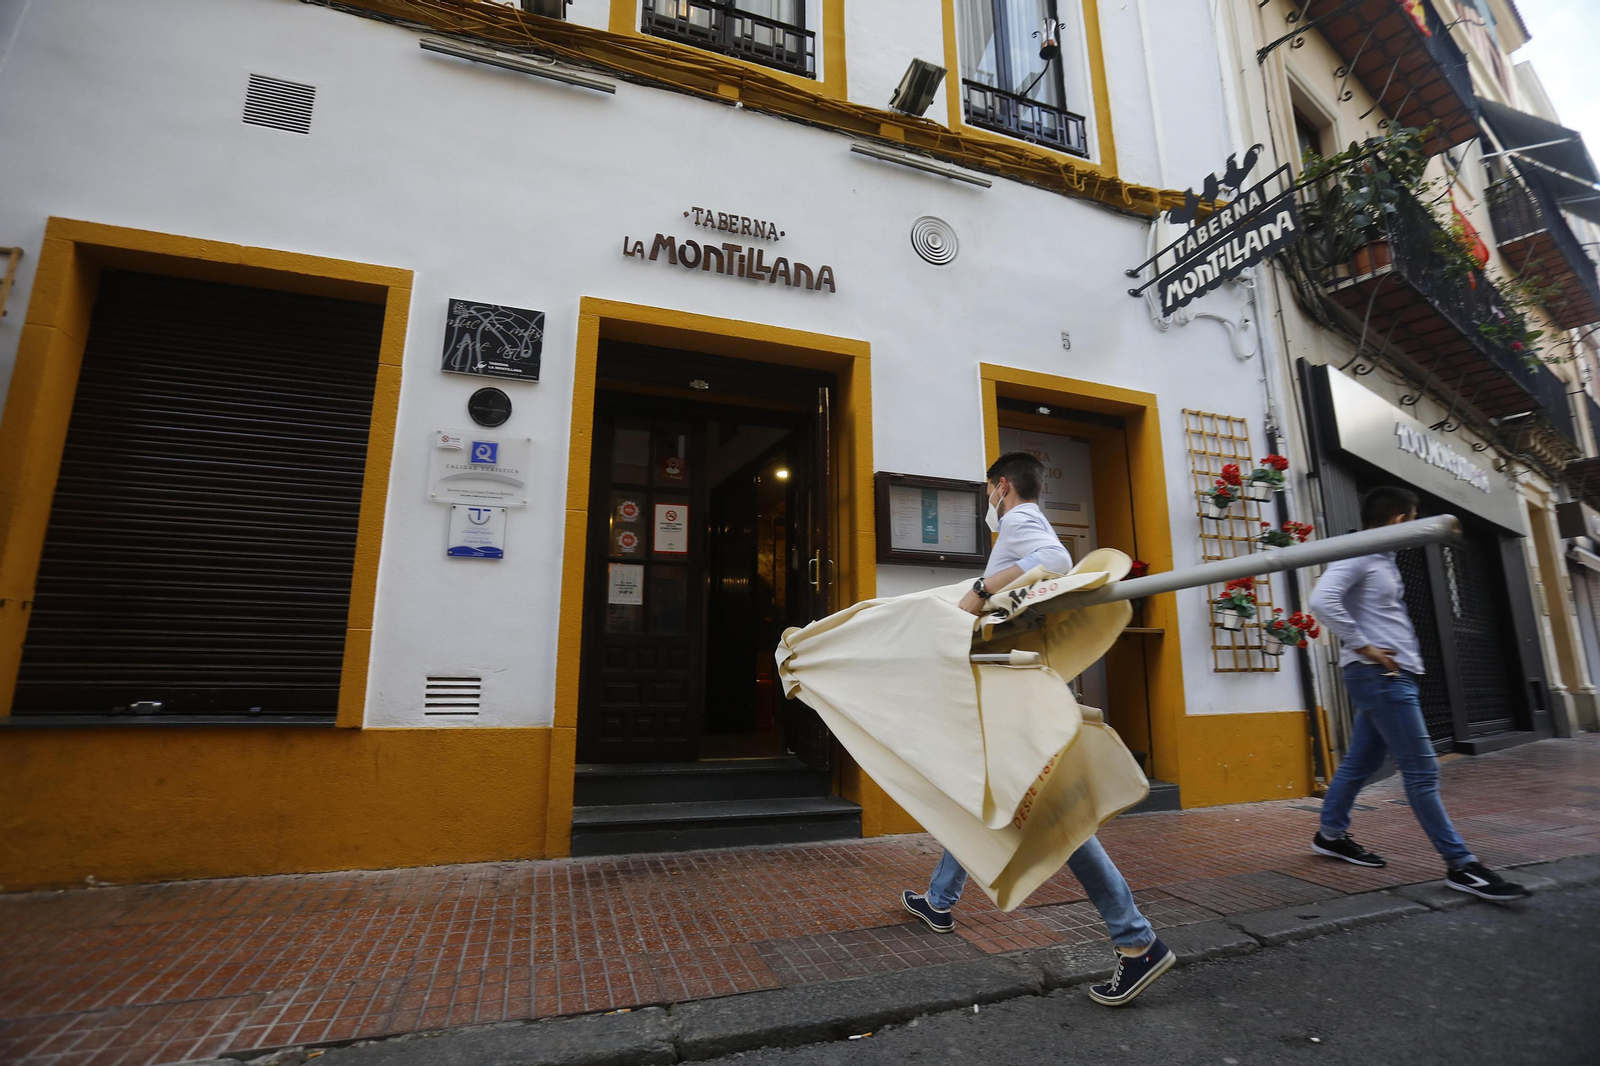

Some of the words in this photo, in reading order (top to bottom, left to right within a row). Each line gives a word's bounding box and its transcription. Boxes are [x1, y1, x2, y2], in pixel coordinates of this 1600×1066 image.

[691, 206, 780, 242] TABERNA
[1175, 190, 1262, 259] TABERNA
[622, 235, 646, 260] LA
[648, 233, 836, 294] MONTILLANA
[1165, 210, 1296, 308] MONTILLANA
[1061, 332, 1071, 350] 5
[445, 463, 478, 471] CALIDAD
[1012, 786, 1038, 830] DESDE
